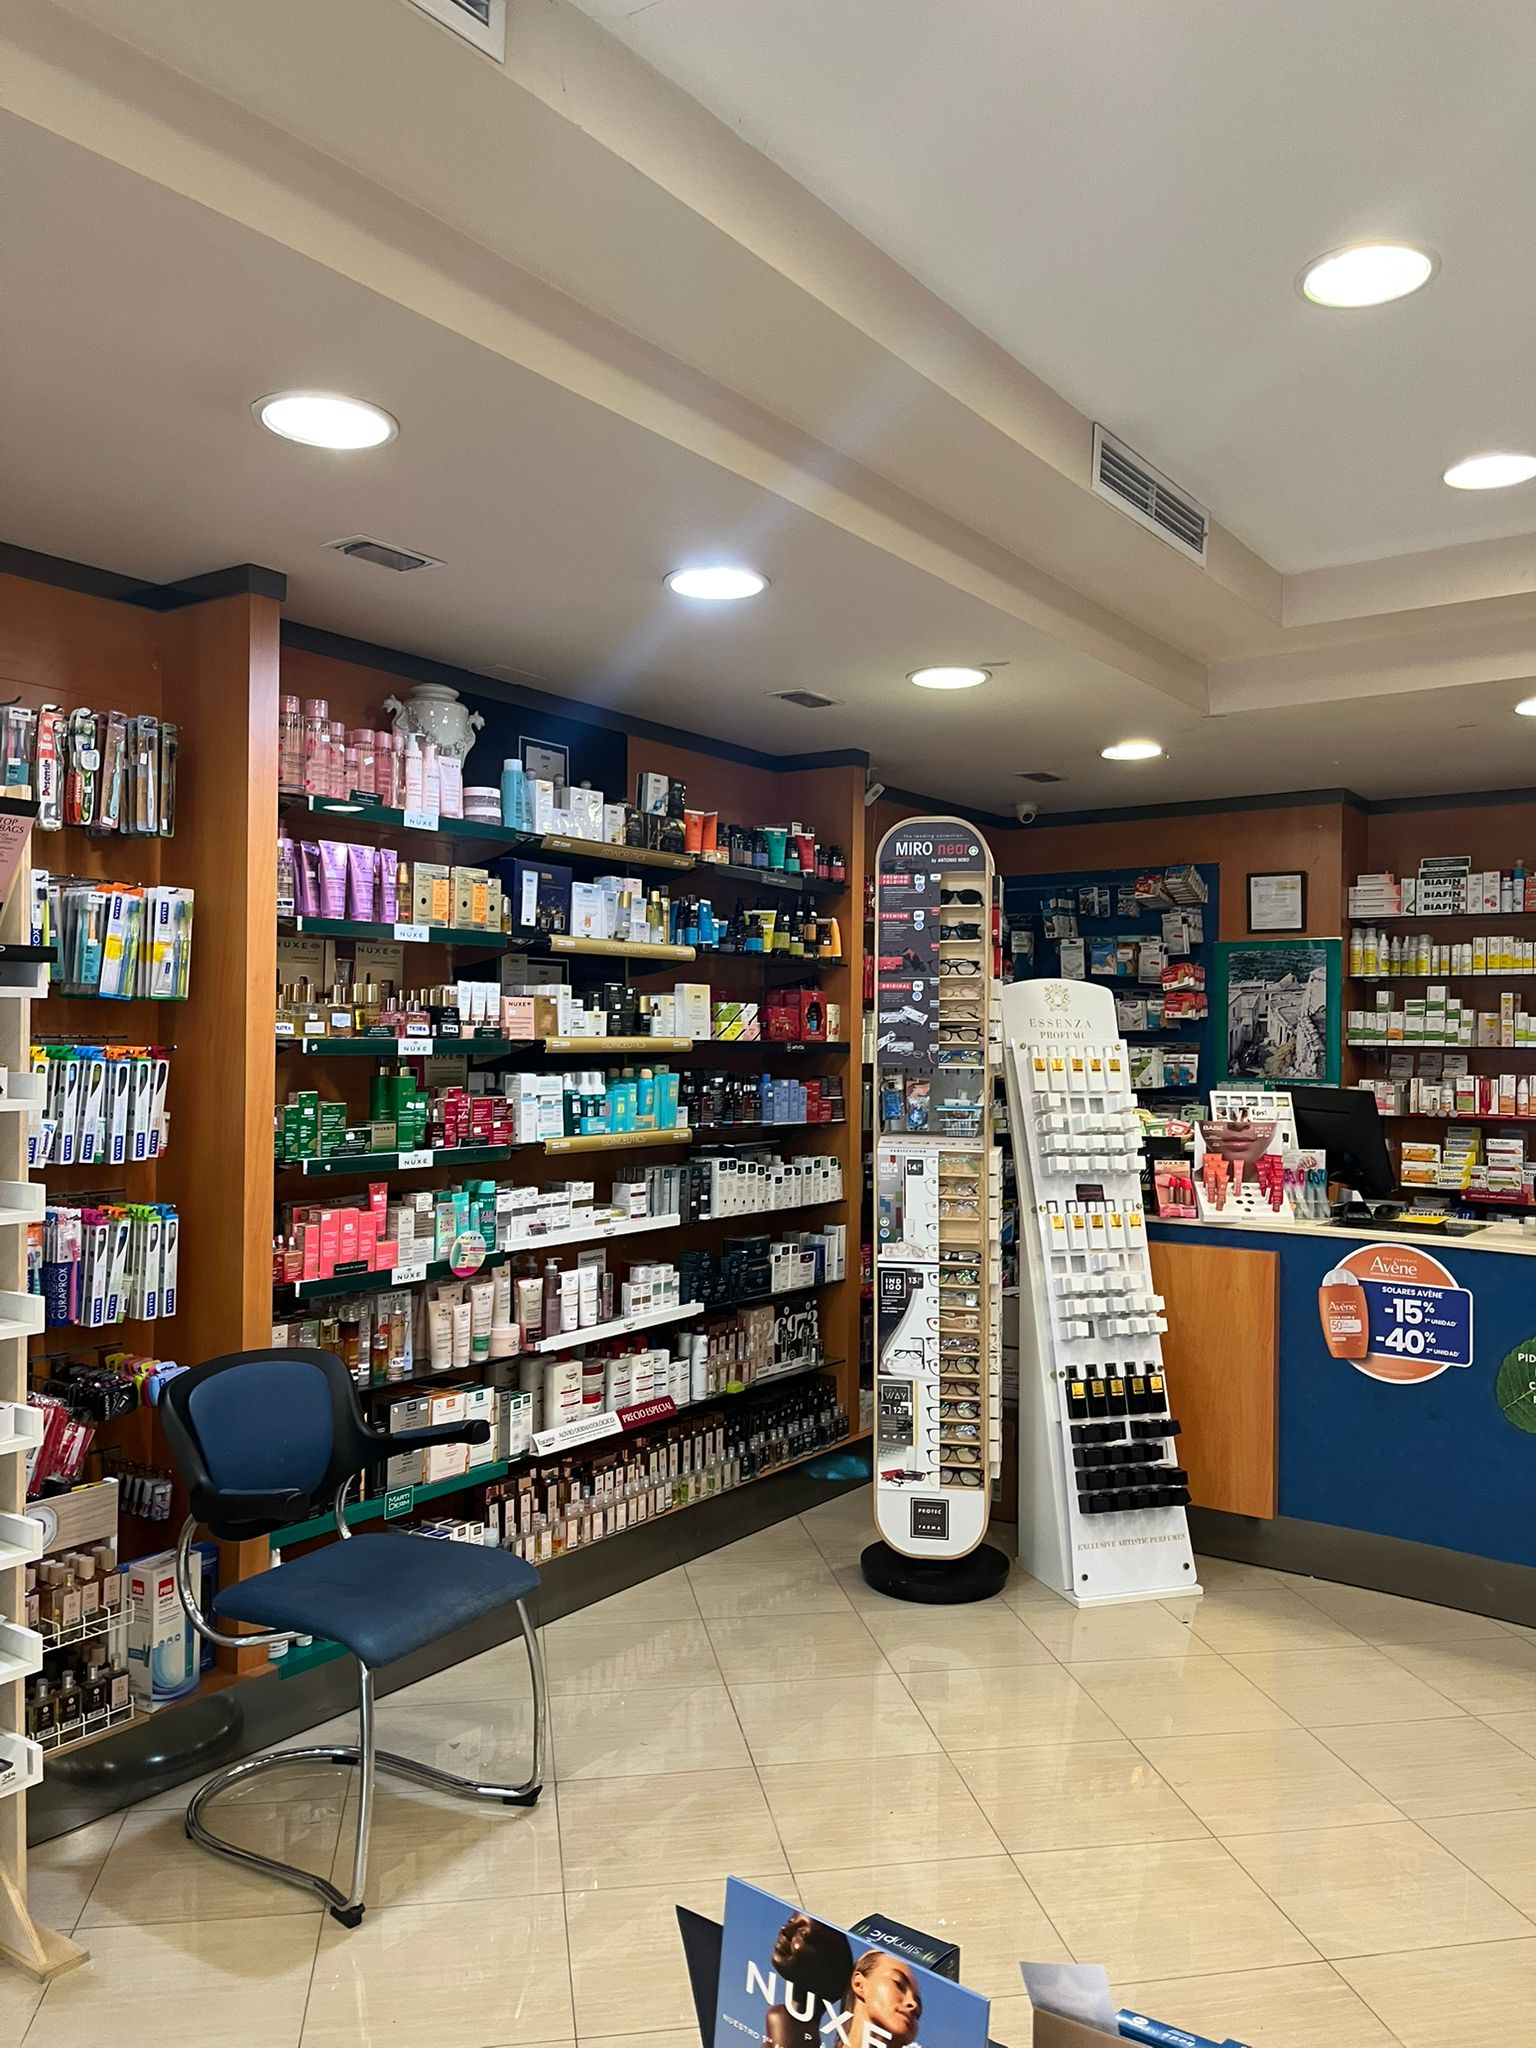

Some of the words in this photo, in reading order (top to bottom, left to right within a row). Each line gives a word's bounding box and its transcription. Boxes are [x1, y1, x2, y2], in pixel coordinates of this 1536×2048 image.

[409, 819, 433, 827] NUXE
[896, 841, 933, 856] MIRO
[938, 844, 970, 855] near
[1424, 879, 1461, 887] BIAFIN
[114, 897, 122, 919] VITIS
[1424, 903, 1460, 911] BIAFIN
[357, 946, 389, 955] NUXE
[1029, 1018, 1092, 1029] ESSENZA
[1040, 1031, 1085, 1040] PROFUMI
[85, 1135, 93, 1160] VITIS
[601, 1136, 646, 1146] ISDINCEUTICS
[1371, 1256, 1417, 1276] Avène
[397, 1272, 421, 1280] NUXE
[57, 1267, 68, 1320] CURAPROX
[1382, 1286, 1416, 1297] SOLARES
[1417, 1289, 1443, 1299] AVÈNE
[108, 1296, 117, 1320] VITIS
[1328, 1301, 1357, 1312] Avène
[1384, 1298, 1435, 1325] -15%
[1376, 1327, 1436, 1354] -40%
[1517, 1353, 1536, 1363] PID
[884, 1392, 907, 1400] WAY
[621, 1410, 646, 1423] PRECIO
[646, 1401, 673, 1416] ESPECIAL
[558, 1428, 574, 1438] ALIVIO
[573, 1416, 616, 1434] DERMATOLÓGICO
[388, 1499, 410, 1512] DERM
[389, 1493, 409, 1505] MARTI
[1078, 1540, 1116, 1551] EXCLUSIVE
[1118, 1537, 1149, 1547] ARTISTIC
[1150, 1533, 1186, 1545] PERFUMES
[869, 1930, 924, 1956] slimpic
[745, 1960, 893, 2048] NUXE
[722, 2012, 760, 2040] NUESTRO
